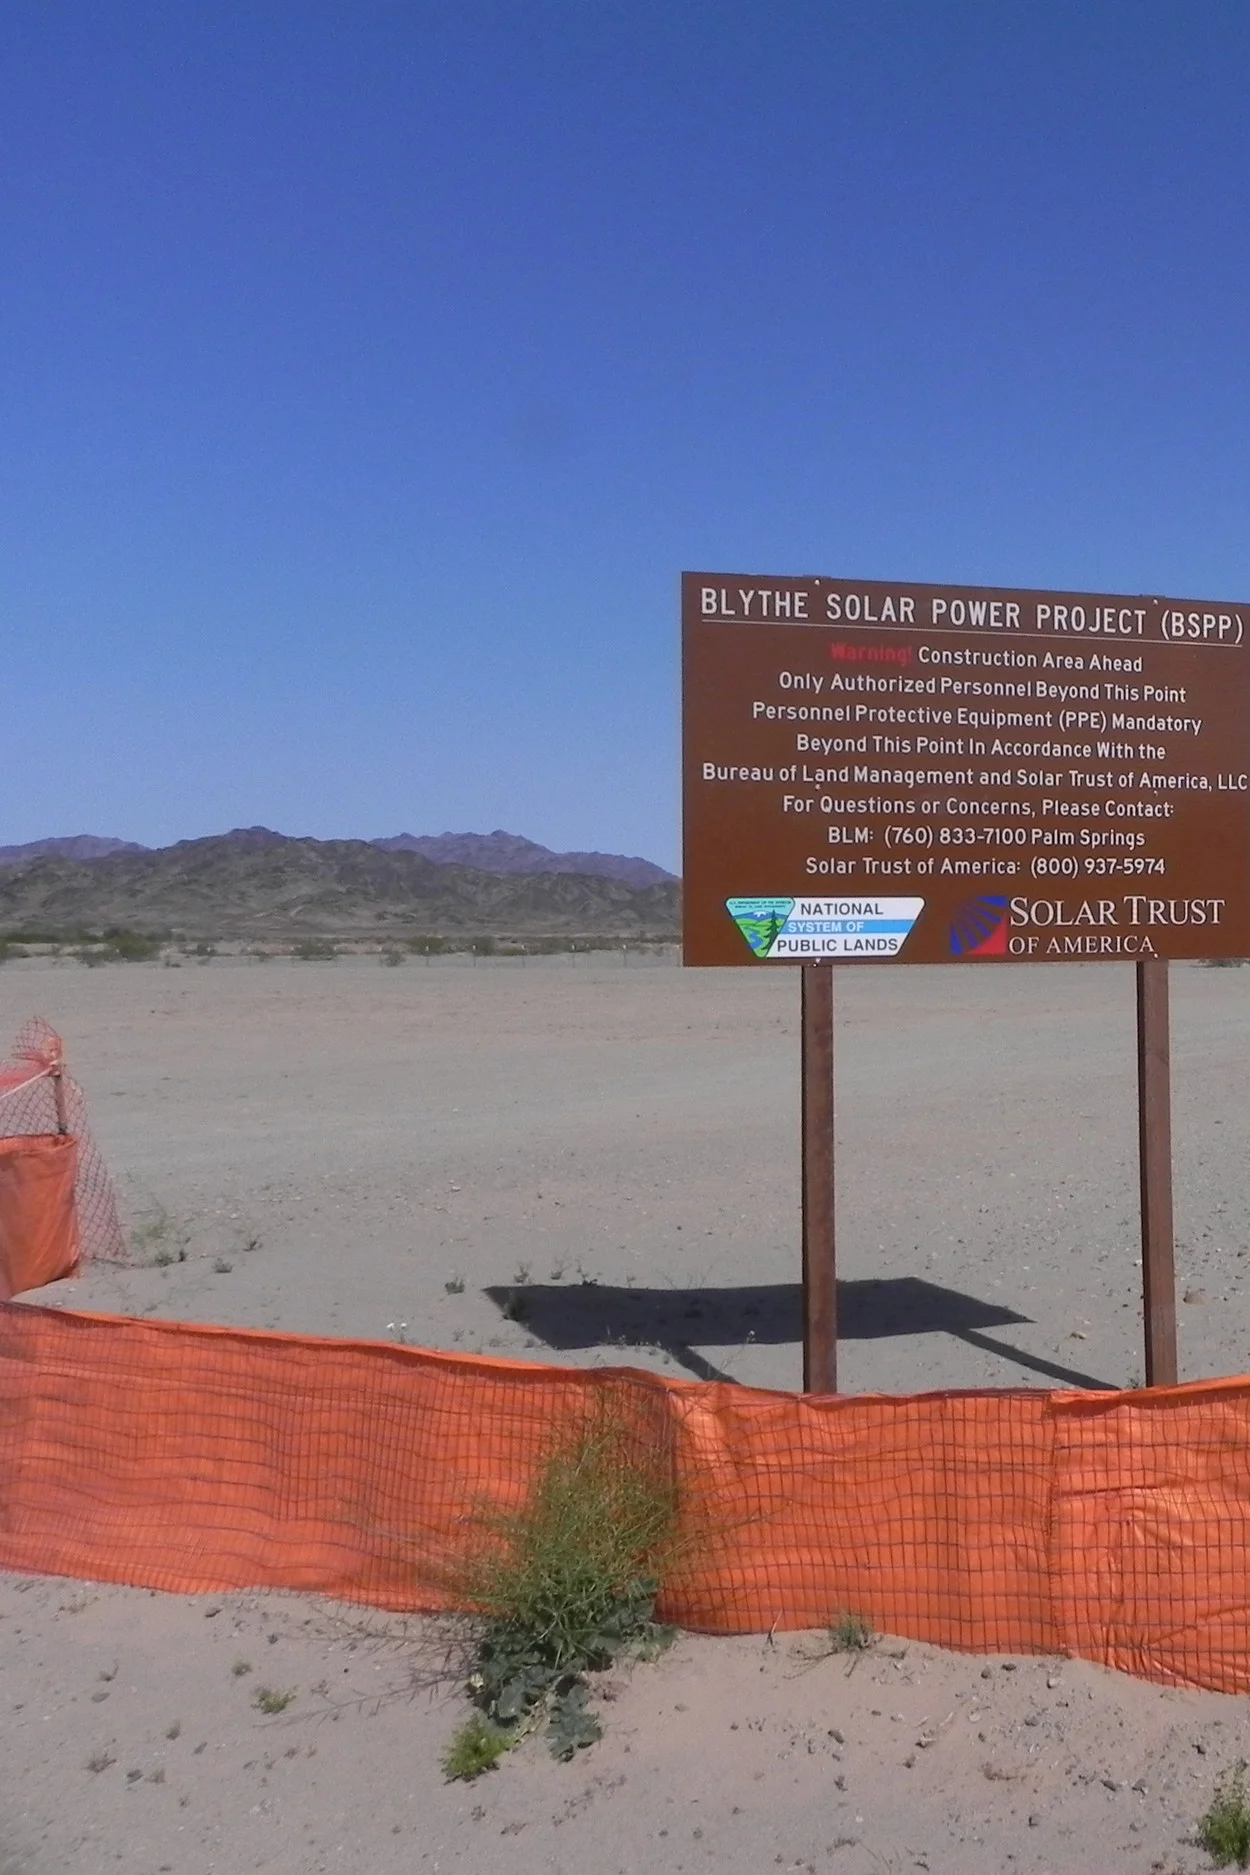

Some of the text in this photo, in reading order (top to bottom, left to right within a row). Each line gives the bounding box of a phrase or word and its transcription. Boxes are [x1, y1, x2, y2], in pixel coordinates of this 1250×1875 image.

[701, 587, 1243, 644] BLYTHE SOLAR POWER PROJECT (BSPP)
[918, 645, 1037, 667] Construction
[1043, 653, 1084, 669] Area
[1089, 655, 1142, 672] Ahead
[779, 671, 1186, 702] Only Authorized Personnel Beyond This Point
[753, 702, 1201, 735] Personnel Protective Equipment (PPE) Mandatory
[797, 734, 1166, 759] Beyond This Point In Accordance With the
[703, 763, 1248, 791] Bureau of Land Management and Solar Trust of America, LLC
[783, 796, 1174, 818] For Questions or Concerns, Please Contact:
[828, 826, 1145, 850] BLM: (760) 833-7100 Palm Springs
[806, 857, 1166, 878] Solar Trust of America: (800) 937-5974
[801, 903, 884, 916] NATIONAL
[1010, 895, 1225, 927] SOLAR TRUST
[788, 921, 864, 933] SYSTEM OF
[777, 939, 898, 952] PUBLIC LANDS
[1009, 936, 1154, 954] OF AMERICA
